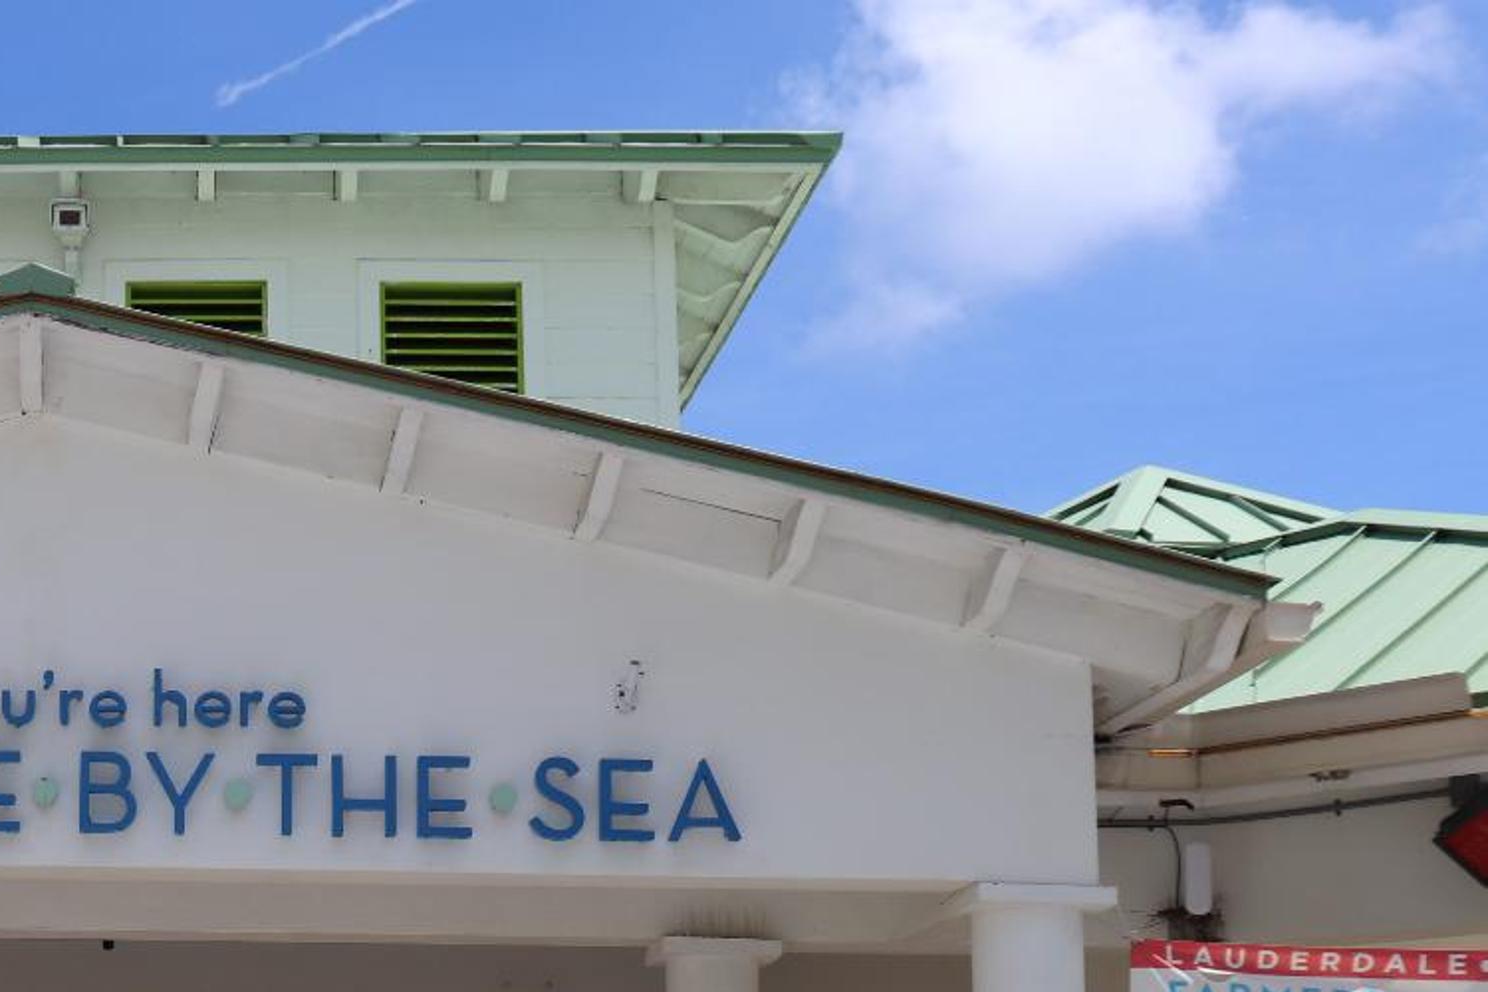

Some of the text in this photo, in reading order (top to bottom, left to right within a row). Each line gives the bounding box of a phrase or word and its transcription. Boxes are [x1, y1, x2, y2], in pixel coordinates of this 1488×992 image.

[153, 668, 306, 729] here
[78, 749, 215, 836] BY
[255, 752, 473, 840] THE
[528, 756, 742, 842] SEA
[1165, 943, 1468, 976] LAUDERDALE
